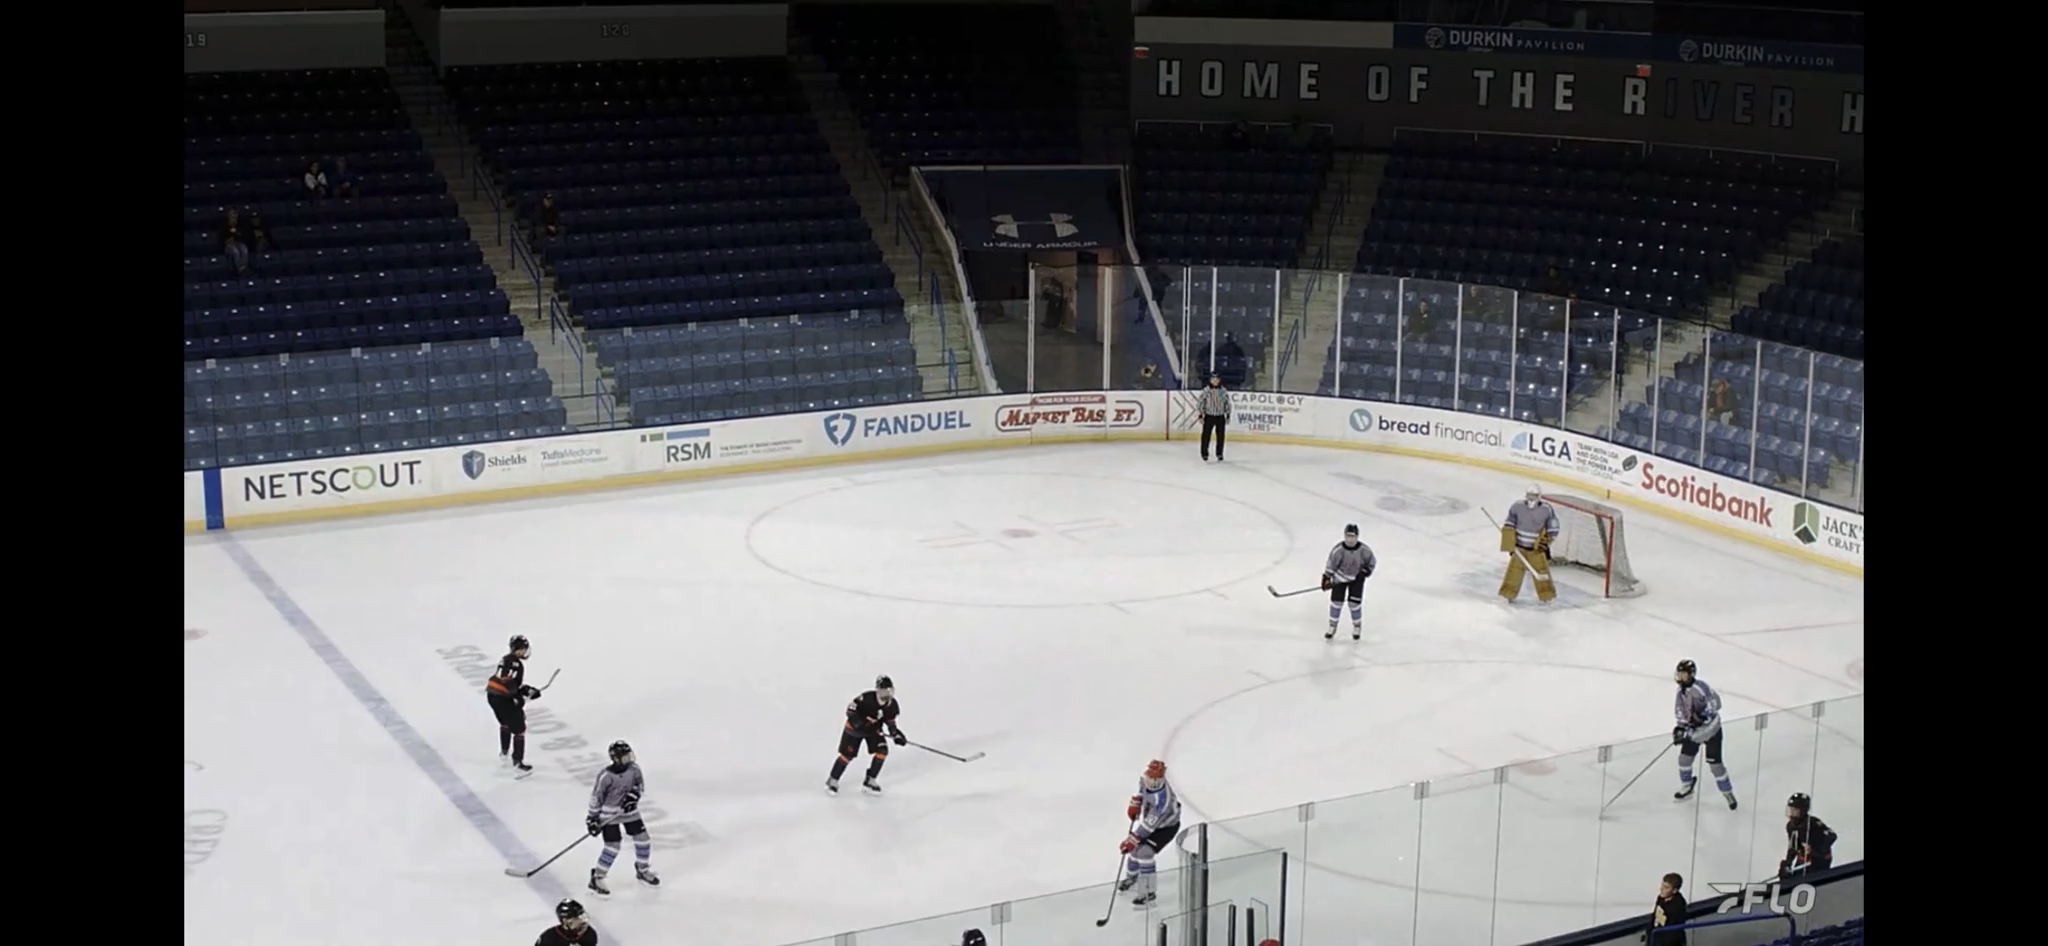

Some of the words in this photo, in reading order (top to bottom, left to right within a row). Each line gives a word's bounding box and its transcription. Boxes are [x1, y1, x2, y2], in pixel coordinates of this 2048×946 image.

[601, 24, 630, 37] 120
[1449, 30, 1513, 47] DURKIN
[1516, 40, 1585, 51] PAVILION
[1702, 42, 1764, 61] DURKIN
[1767, 53, 1835, 66] PAVILION
[1157, 59, 1320, 100] HOME
[1366, 64, 1430, 103] OF
[1473, 68, 1574, 112] THE
[1622, 76, 1796, 128] RIVER
[983, 241, 1031, 249] UNDER
[1036, 241, 1098, 249] ARMOUR
[1231, 393, 1305, 406] CAPOLOGY
[1279, 406, 1300, 414] game
[863, 410, 971, 438] FANDUEL
[1072, 407, 1136, 424] BASET
[1237, 413, 1284, 426] WAMESIT
[1379, 415, 1431, 437] bread
[1434, 421, 1502, 448] financial
[666, 442, 712, 463] RSM
[1528, 433, 1572, 461] LGA
[487, 455, 527, 468] Shields
[244, 460, 421, 502] NETSCOUT
[1641, 462, 1774, 528] Scotiabank
[1822, 516, 1864, 540] JACK'
[1828, 536, 1861, 554] CRAFT
